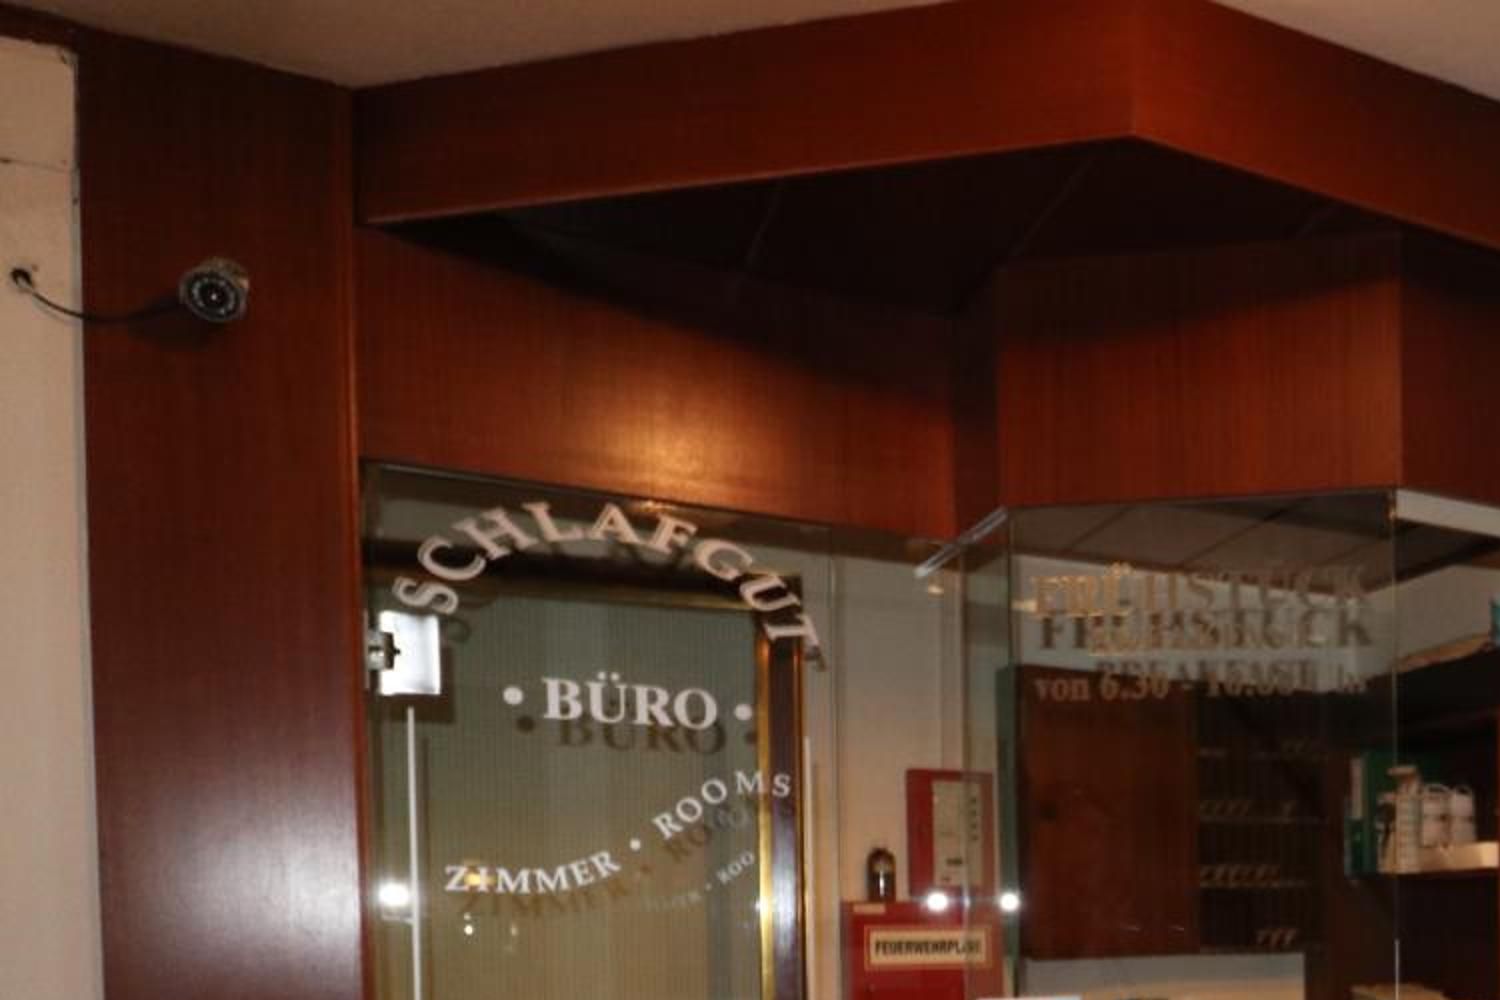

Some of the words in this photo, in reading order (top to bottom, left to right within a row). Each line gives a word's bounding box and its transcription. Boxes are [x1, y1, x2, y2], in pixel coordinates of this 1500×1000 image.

[393, 501, 827, 672] SCHLAFGUT
[541, 670, 718, 731] BÜRO
[1034, 678, 1091, 701] von
[1100, 671, 1169, 700] 6.30
[443, 849, 621, 895] ZIMMER
[652, 767, 792, 839] ROOMS
